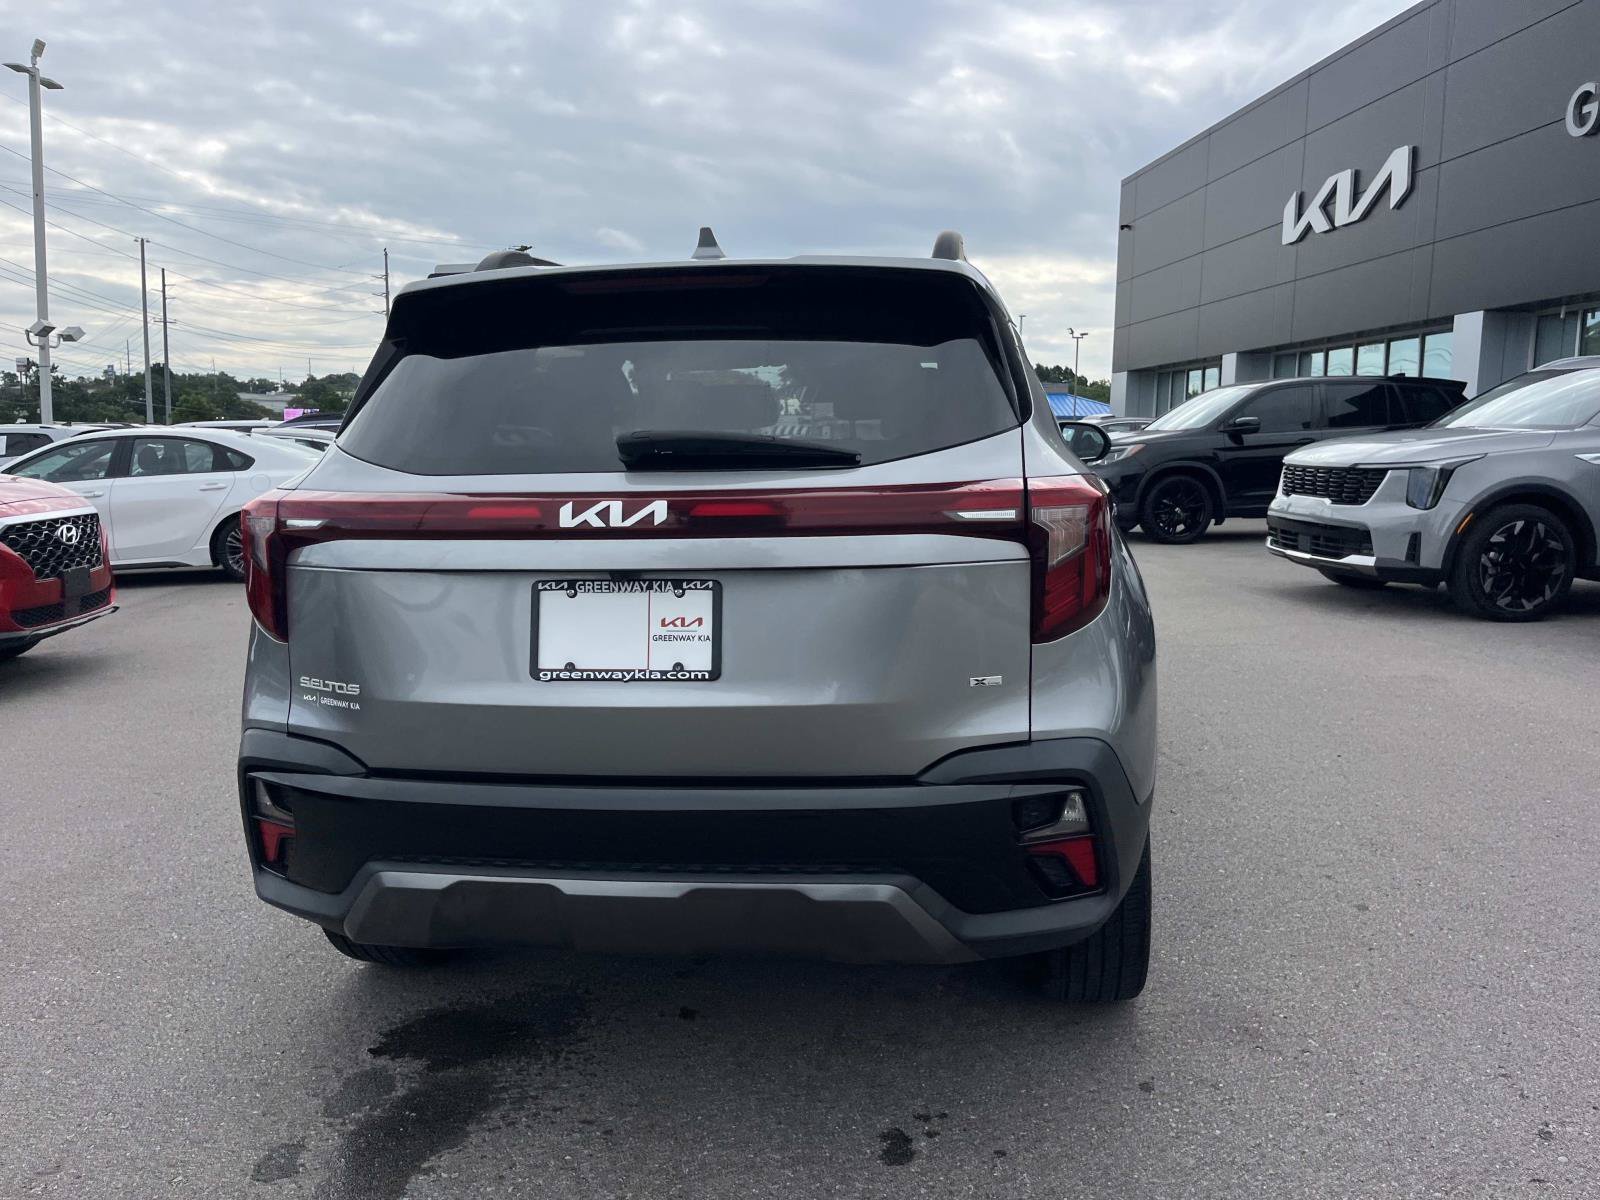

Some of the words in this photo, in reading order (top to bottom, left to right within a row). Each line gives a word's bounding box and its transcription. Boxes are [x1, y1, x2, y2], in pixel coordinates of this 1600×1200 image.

[1565, 81, 1599, 138] G
[1281, 145, 1413, 246] KIA
[559, 499, 668, 528] KIA
[575, 581, 648, 594] GREENWAY
[652, 581, 675, 593] KIA
[660, 616, 704, 628] KIA
[652, 634, 696, 642] GREENWAY
[698, 634, 711, 642] KIA
[539, 669, 710, 681] greenwaykia.com
[300, 676, 361, 694] SELTOS
[320, 696, 349, 708] GREENWAY
[350, 702, 361, 710] KIA
